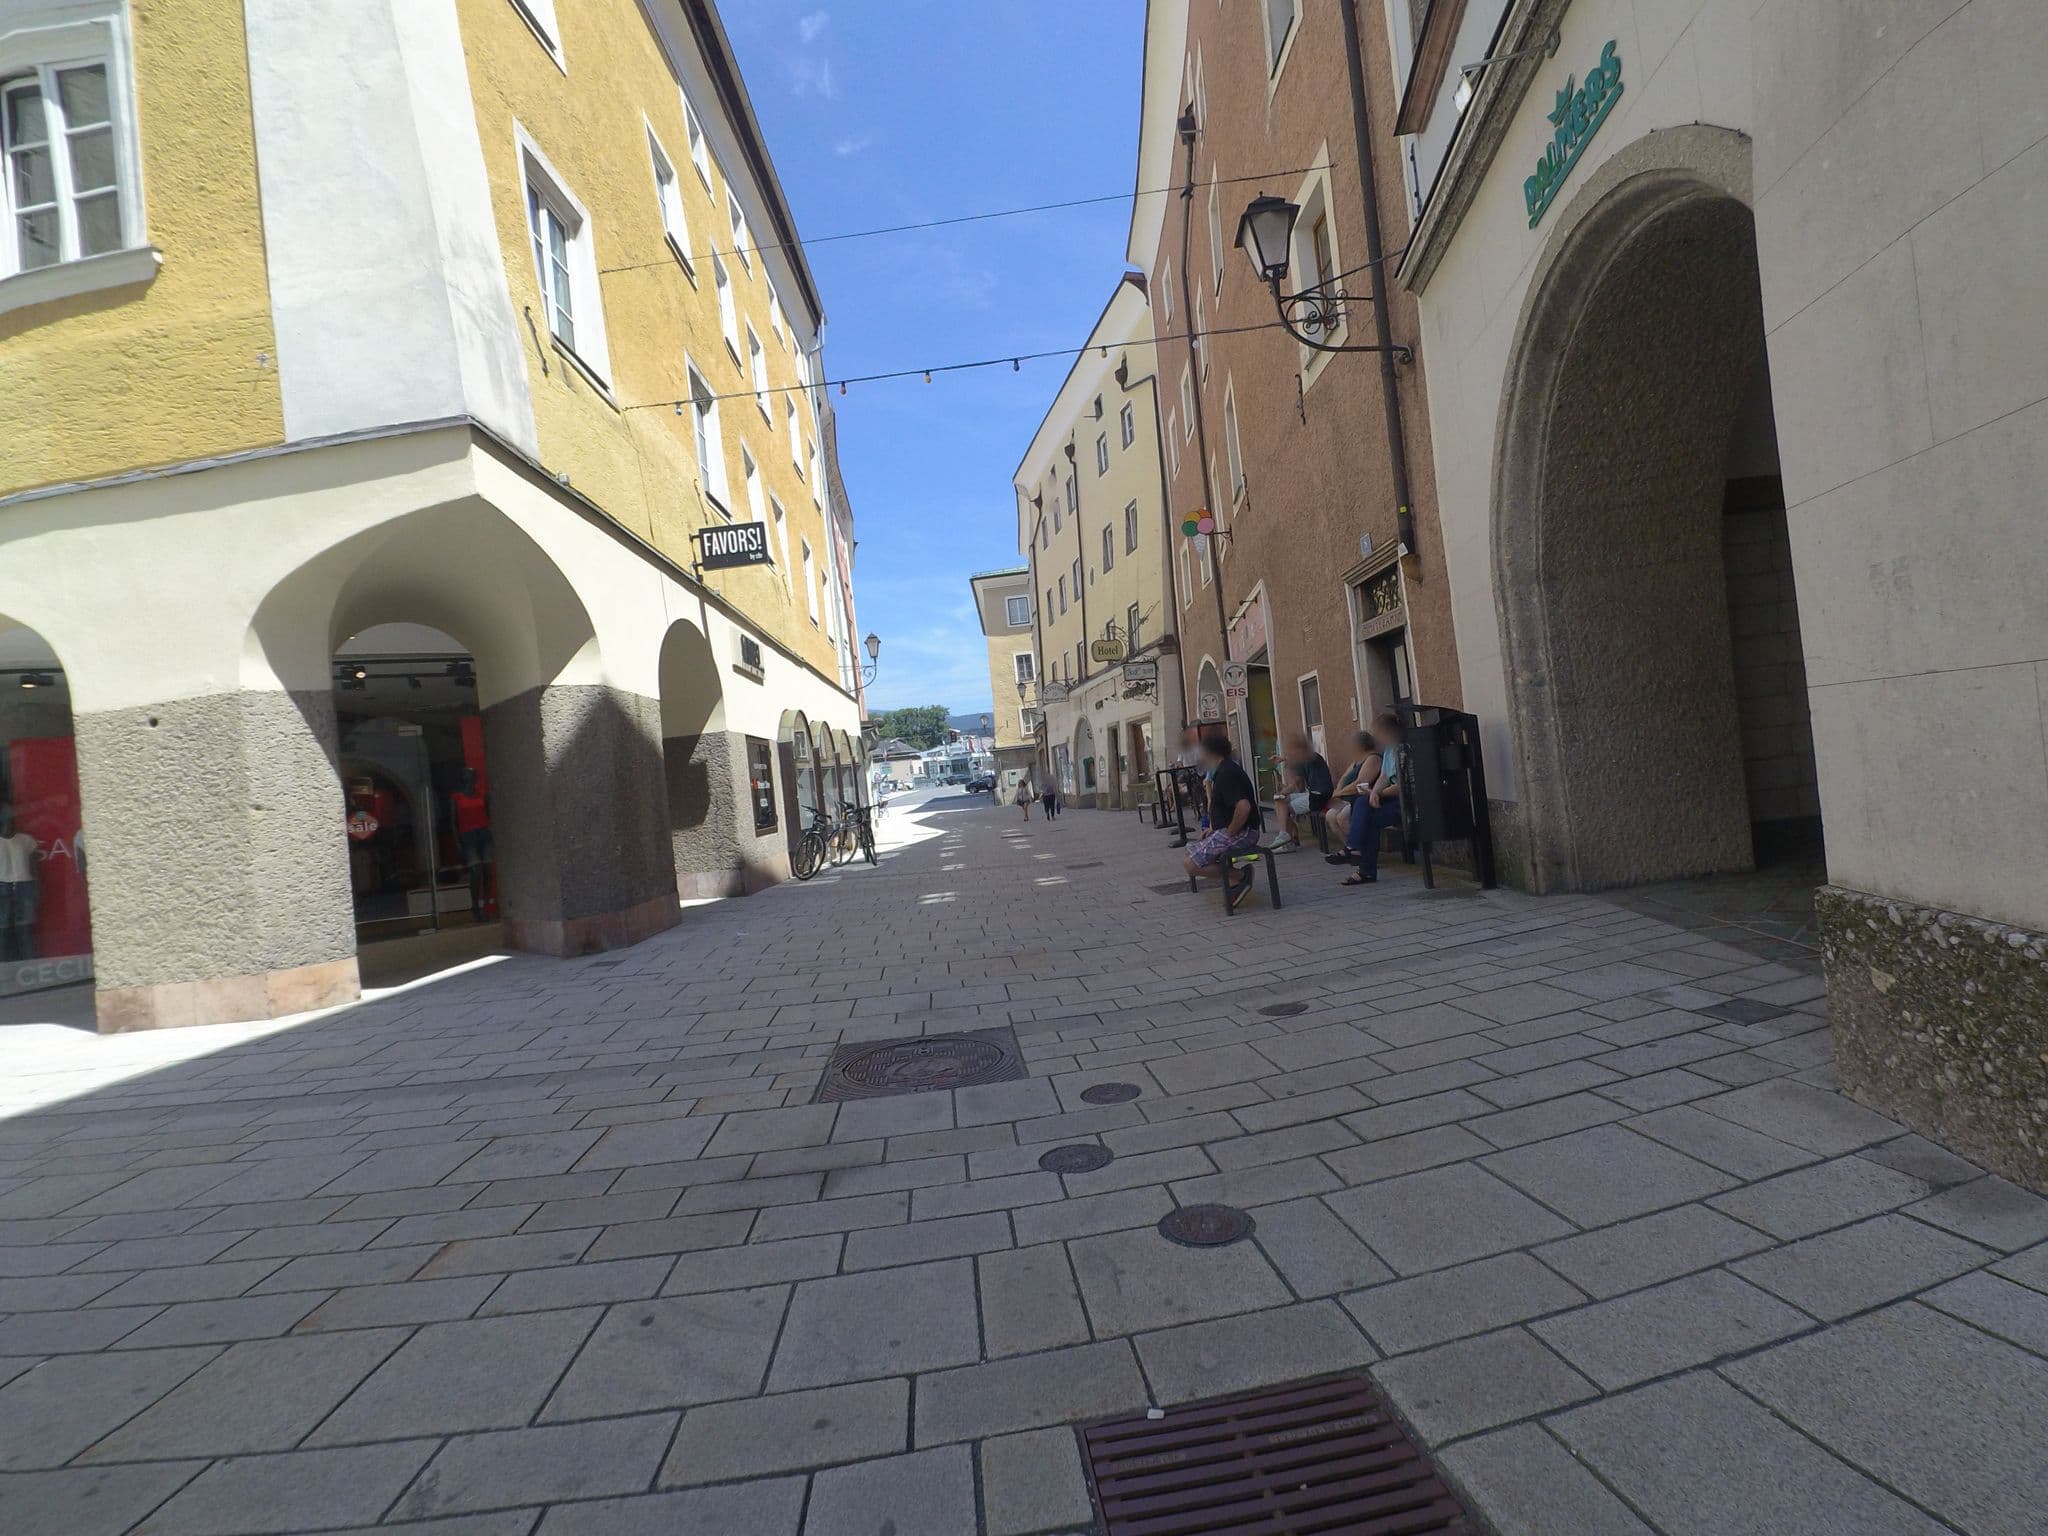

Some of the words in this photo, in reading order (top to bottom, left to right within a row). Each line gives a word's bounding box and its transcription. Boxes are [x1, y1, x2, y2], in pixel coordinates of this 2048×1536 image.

[1524, 40, 1621, 216] PALMERS
[703, 527, 762, 557] FAVORS!
[1097, 645, 1119, 655] Hotel
[1226, 688, 1246, 697] EIS
[1203, 710, 1218, 718] EIS
[34, 838, 73, 862] SA
[16, 960, 93, 987] CECI
